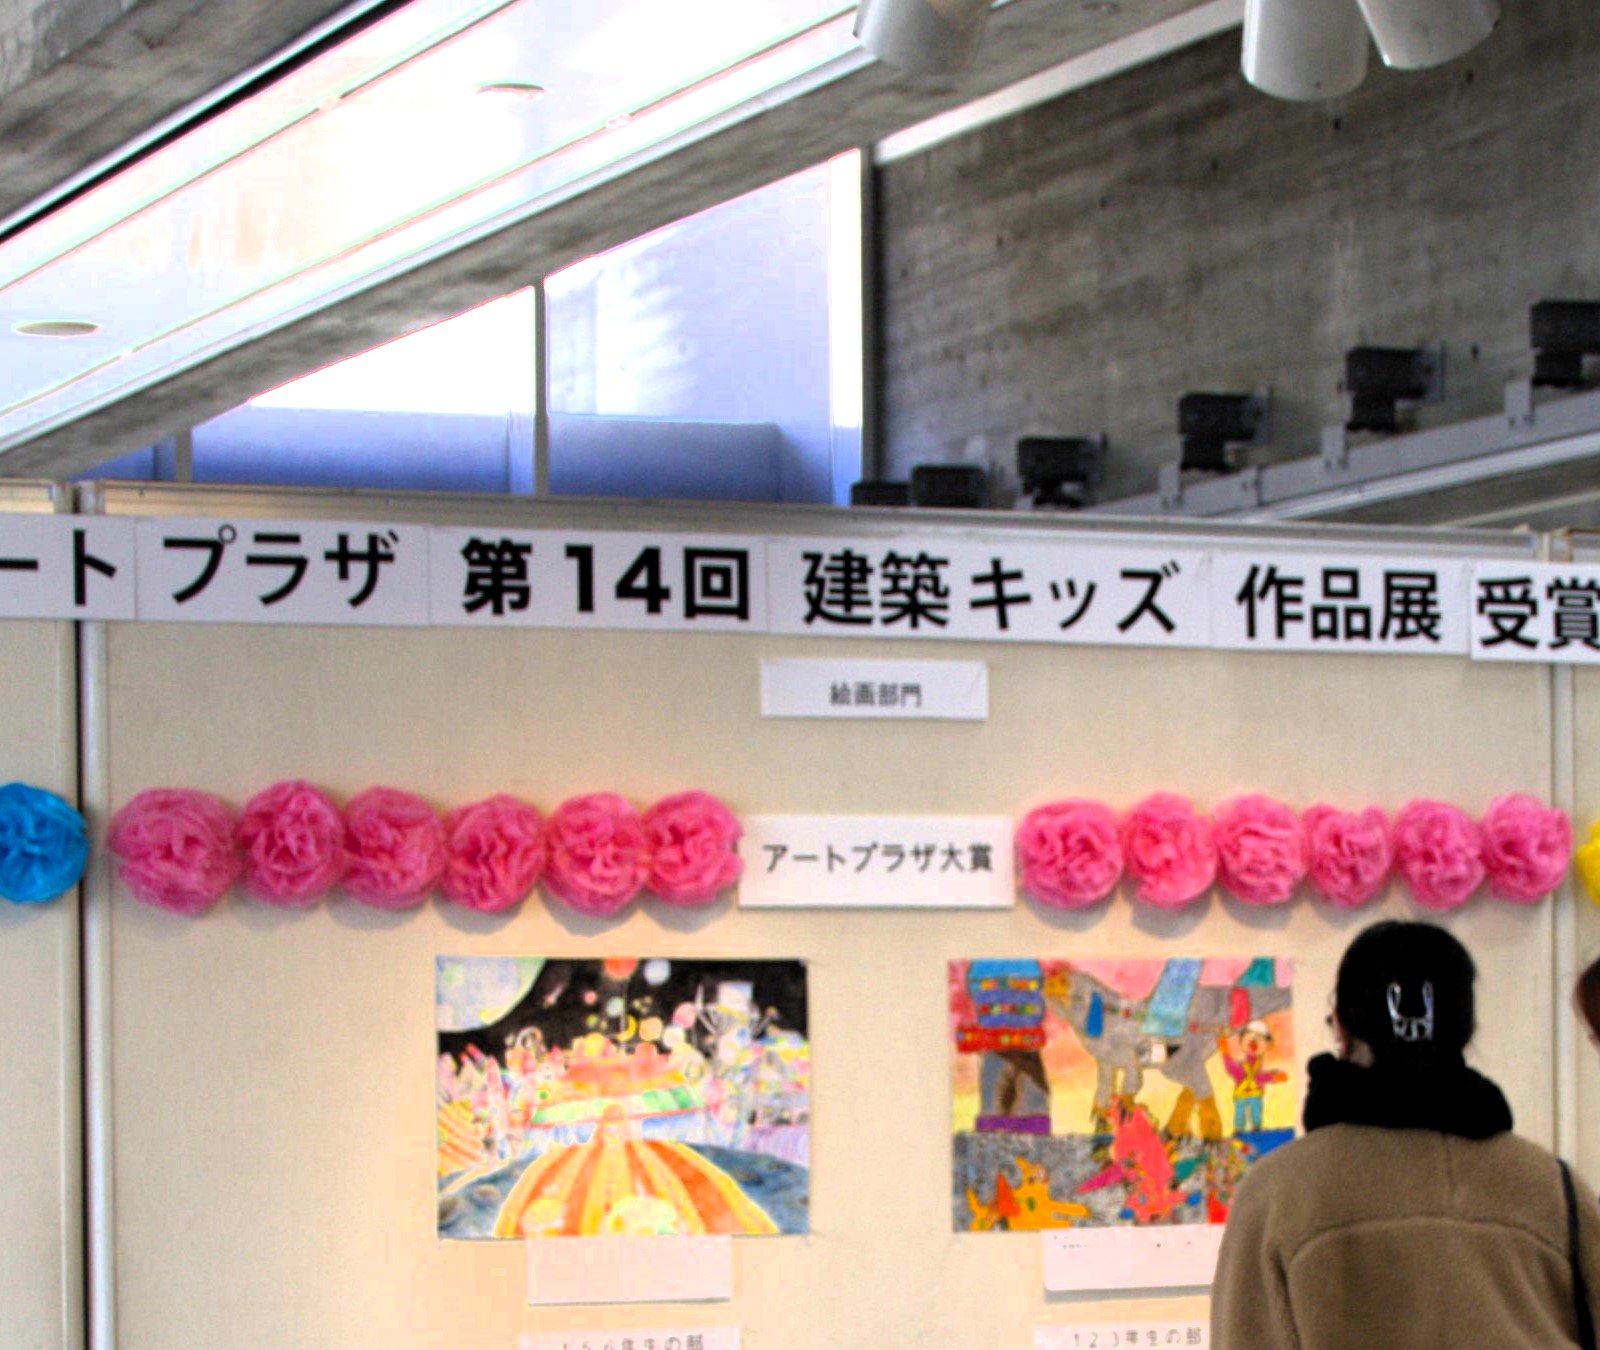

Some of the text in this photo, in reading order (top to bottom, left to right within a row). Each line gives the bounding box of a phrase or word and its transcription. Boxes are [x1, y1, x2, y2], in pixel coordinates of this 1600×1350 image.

[162, 524, 399, 608] プラザ
[801, 548, 1180, 633] 建築キッズ
[1236, 564, 1442, 643] 作品展
[829, 681, 922, 707] 絵画部門
[762, 842, 993, 873] アートプラザ大賞
